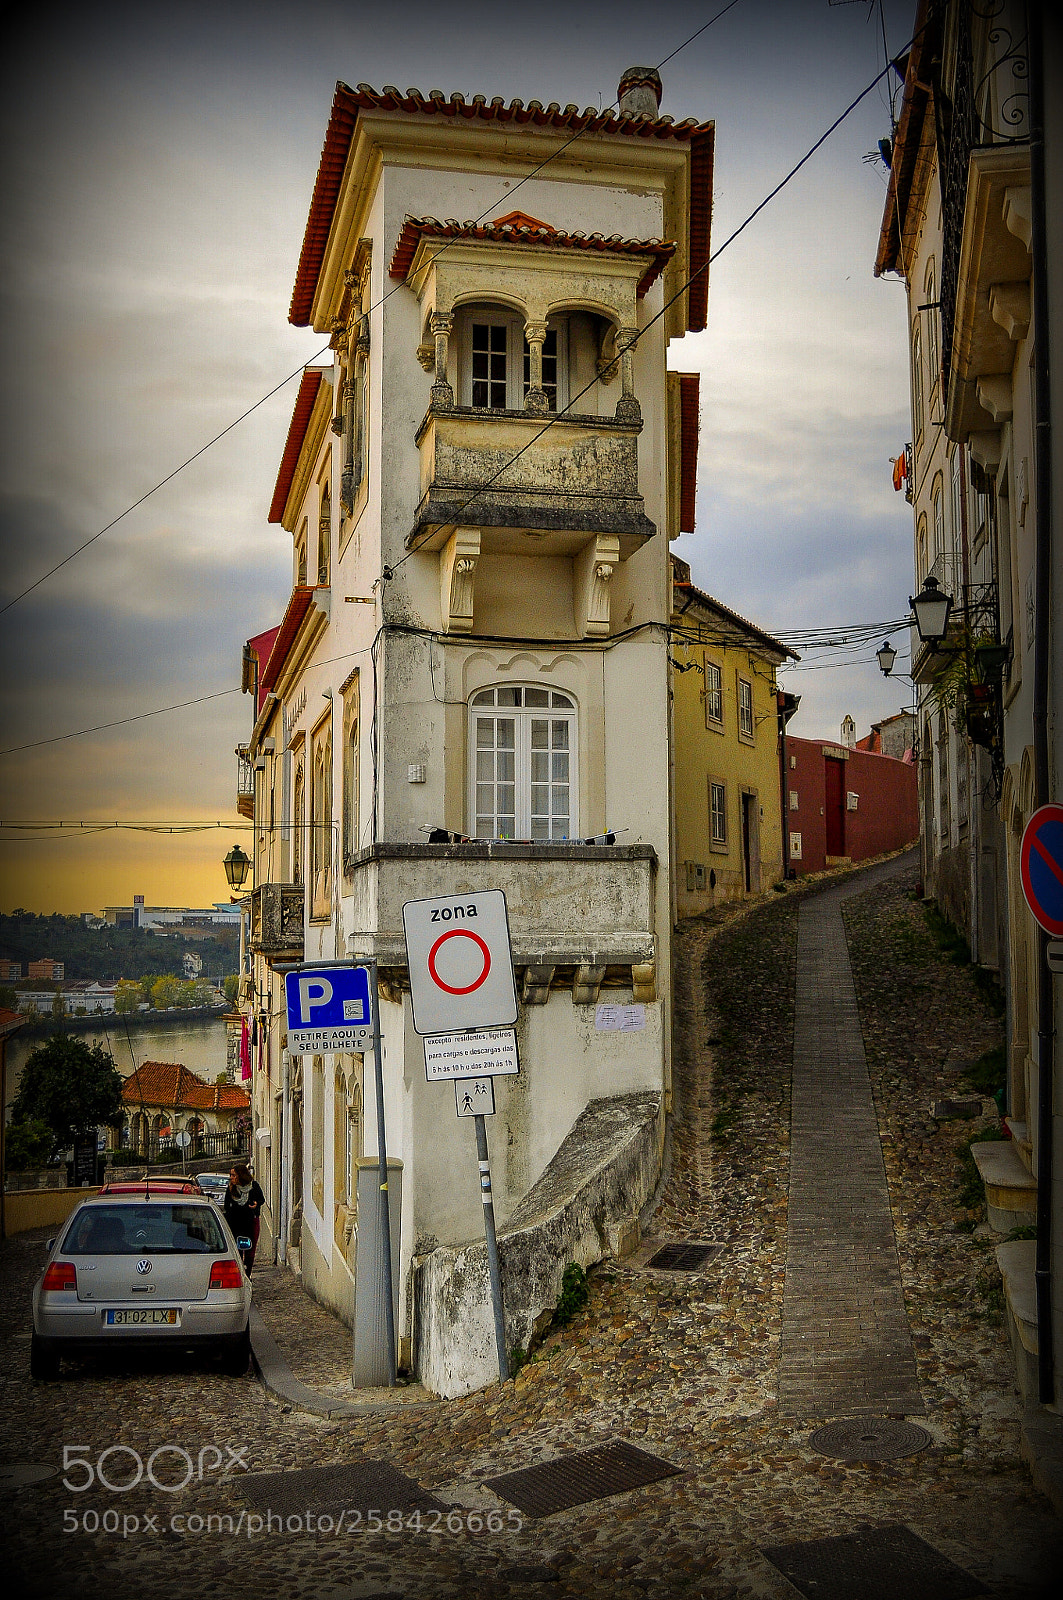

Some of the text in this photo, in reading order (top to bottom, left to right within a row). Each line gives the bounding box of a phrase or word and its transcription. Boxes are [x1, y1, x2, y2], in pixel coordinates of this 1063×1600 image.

[431, 904, 477, 922] zona
[299, 977, 333, 1023] P
[293, 1029, 367, 1042] RETIRE AQUI O
[299, 1040, 363, 1051] SEU BILHETE
[442, 1050, 464, 1058] cargas
[469, 1046, 501, 1055] descargas
